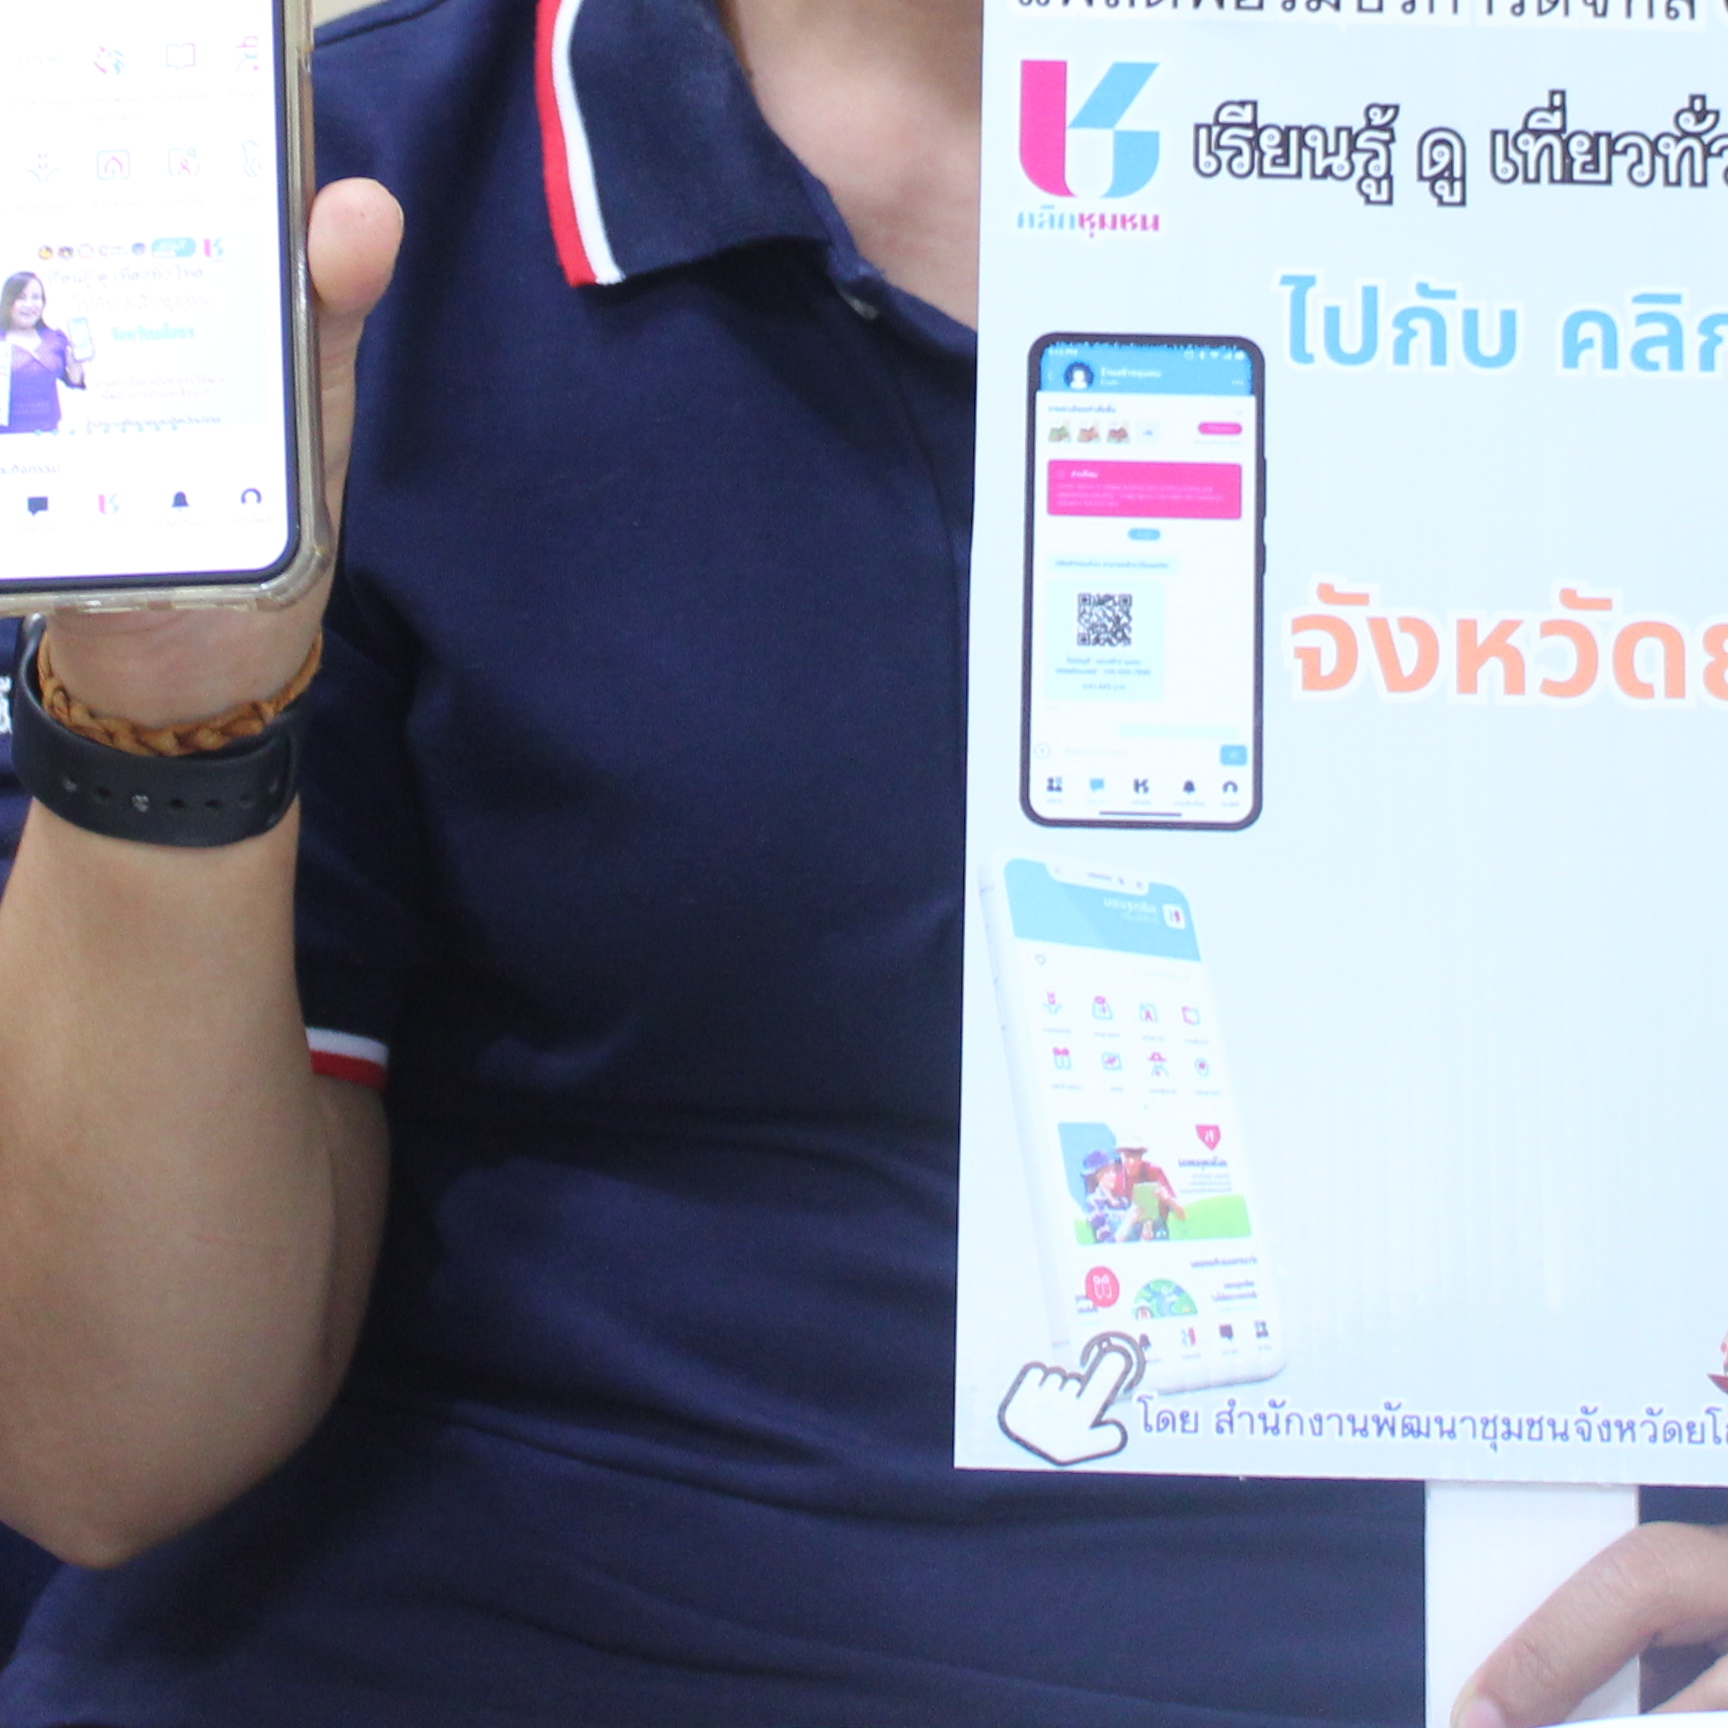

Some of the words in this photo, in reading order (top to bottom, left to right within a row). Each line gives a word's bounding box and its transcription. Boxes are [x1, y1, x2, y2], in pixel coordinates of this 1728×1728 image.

[1193, 99, 1400, 207] เรียนรู้
[1417, 126, 1467, 208] ดู
[1280, 275, 1516, 368] ไปกับ
[1136, 1394, 1199, 1435] โดย
